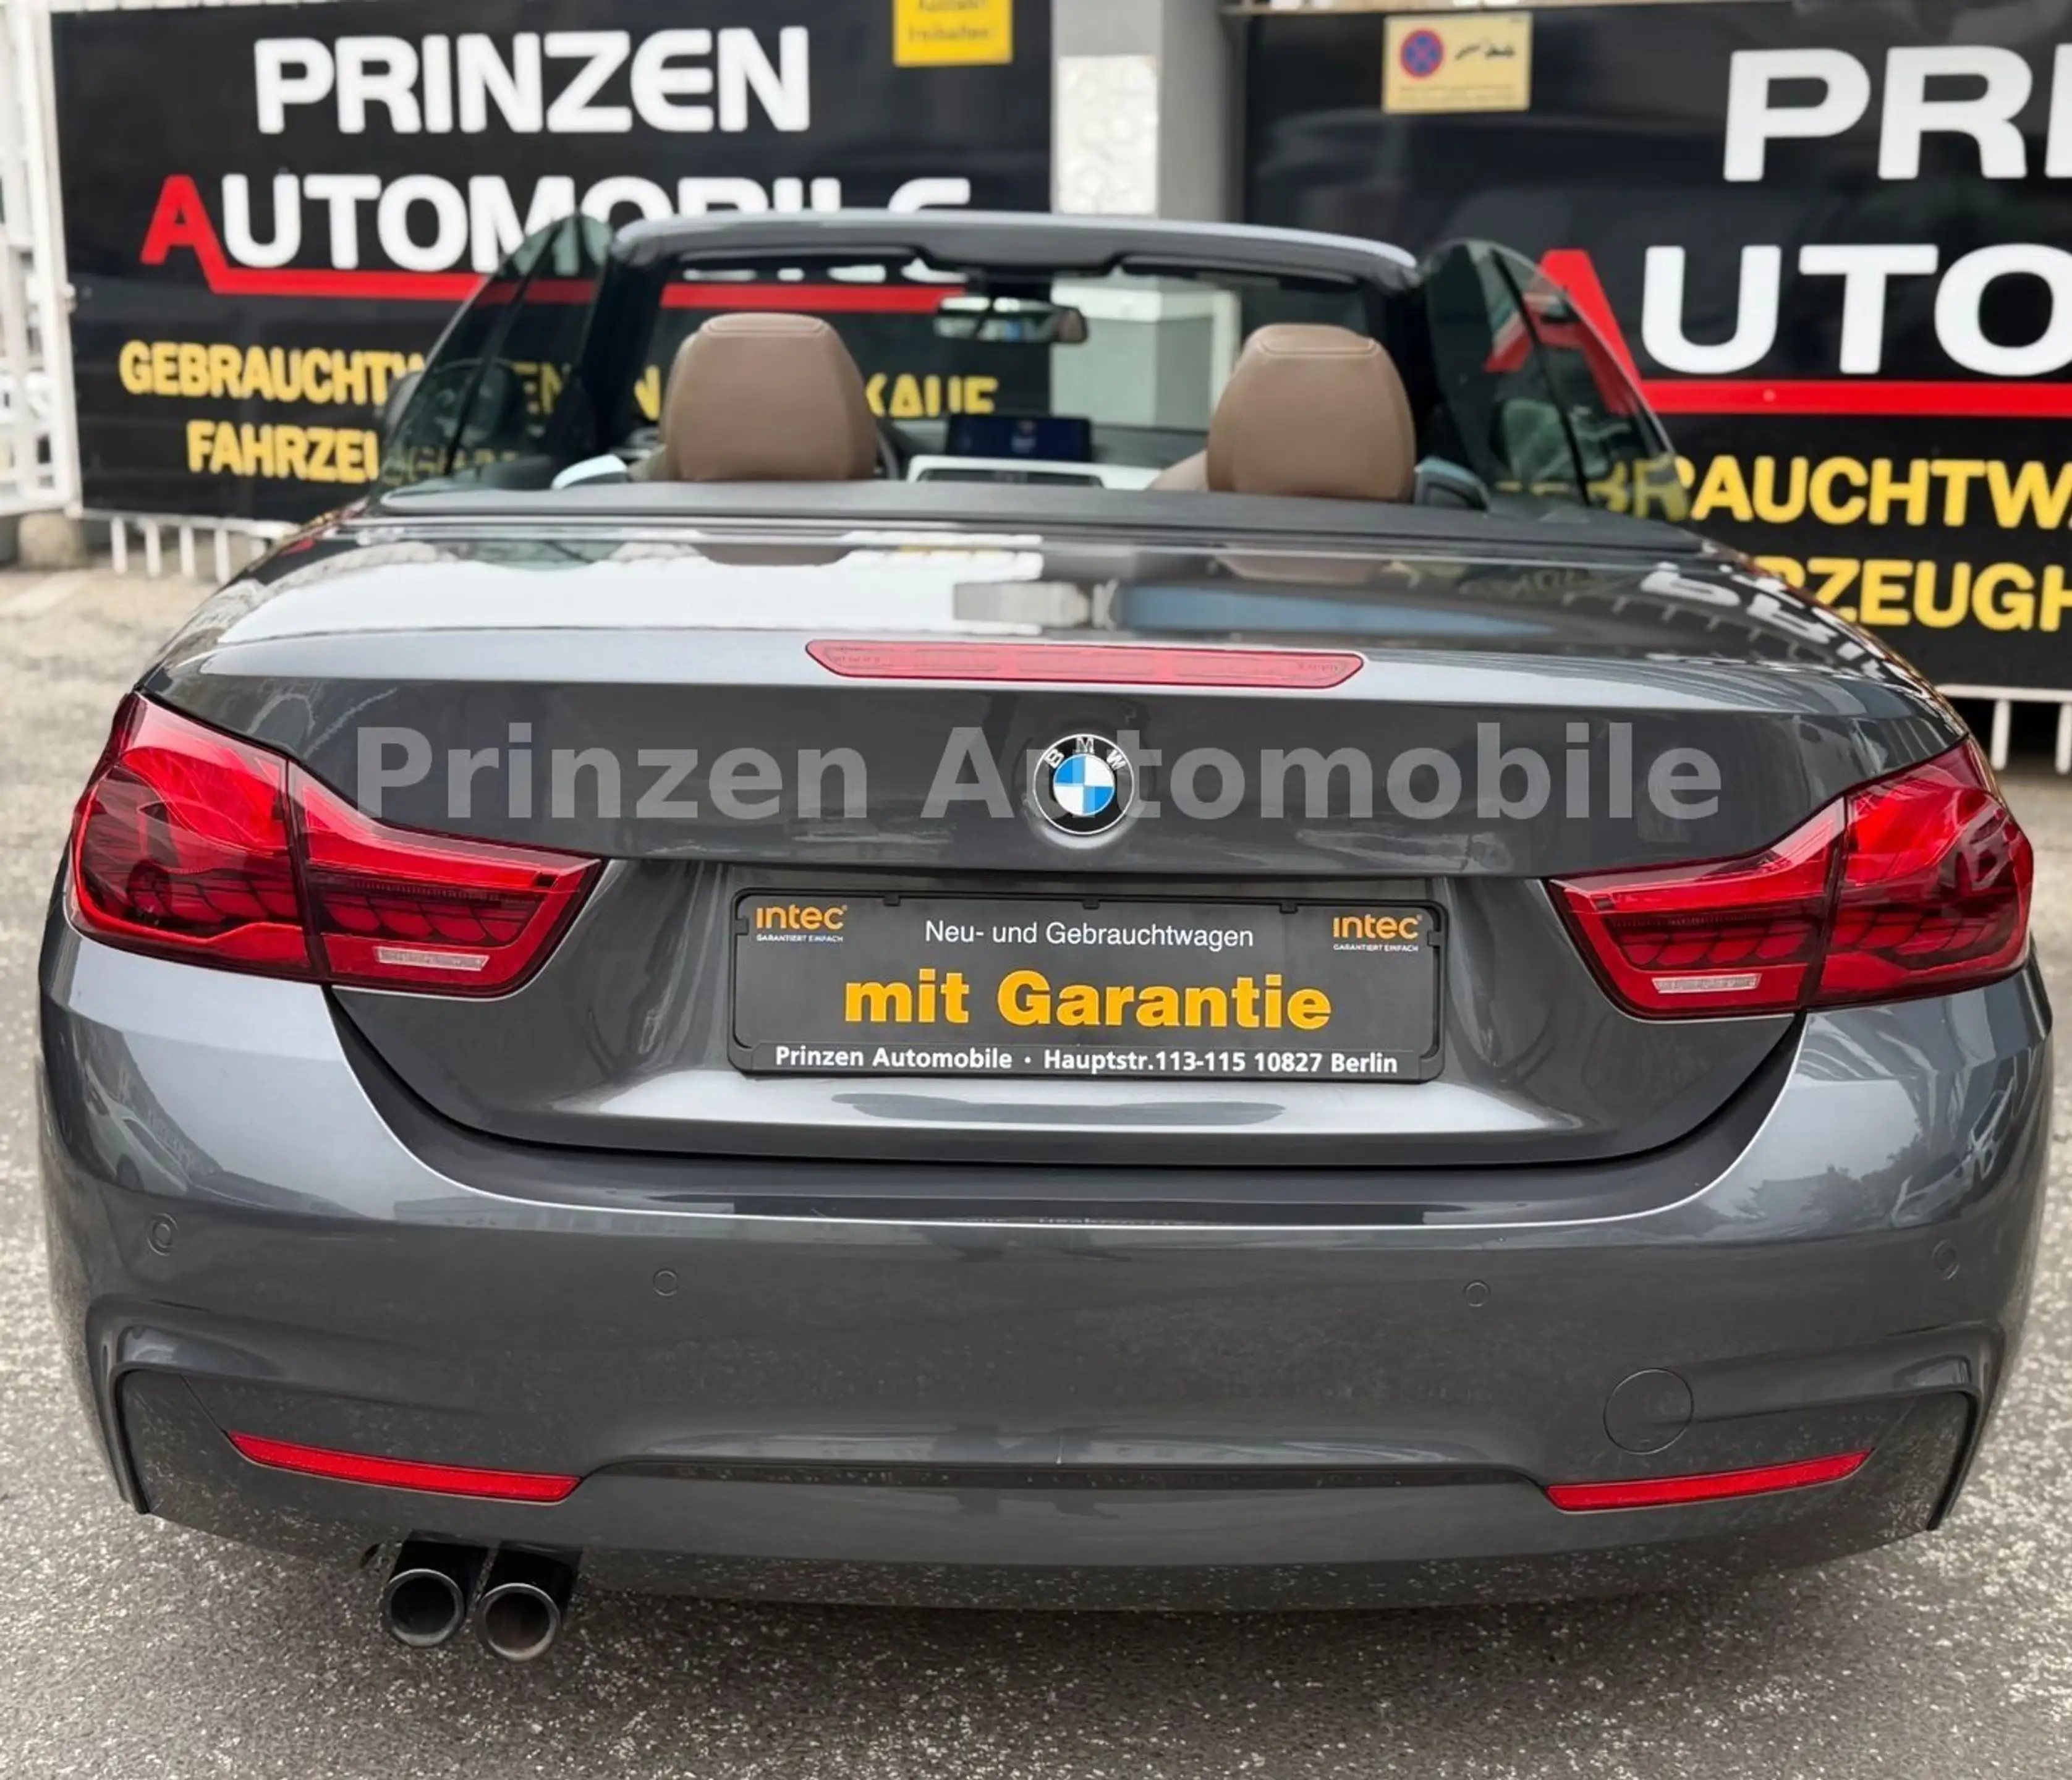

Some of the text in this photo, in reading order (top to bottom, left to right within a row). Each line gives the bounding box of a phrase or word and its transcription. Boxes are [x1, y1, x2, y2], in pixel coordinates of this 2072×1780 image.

[254, 26, 810, 134] PRINZEN
[1044, 736, 1127, 771] BMW
[756, 933, 807, 943] GARANTIERT
[925, 920, 1254, 952] Neu- und Gebrauchtwagen
[1333, 943, 1419, 952] GARANTIERT EINFACH
[844, 968, 1332, 1031] mit Garantie
[775, 1045, 1398, 1075] Prinzen Automobile Hauptstr.113-115 10827 Berlin
